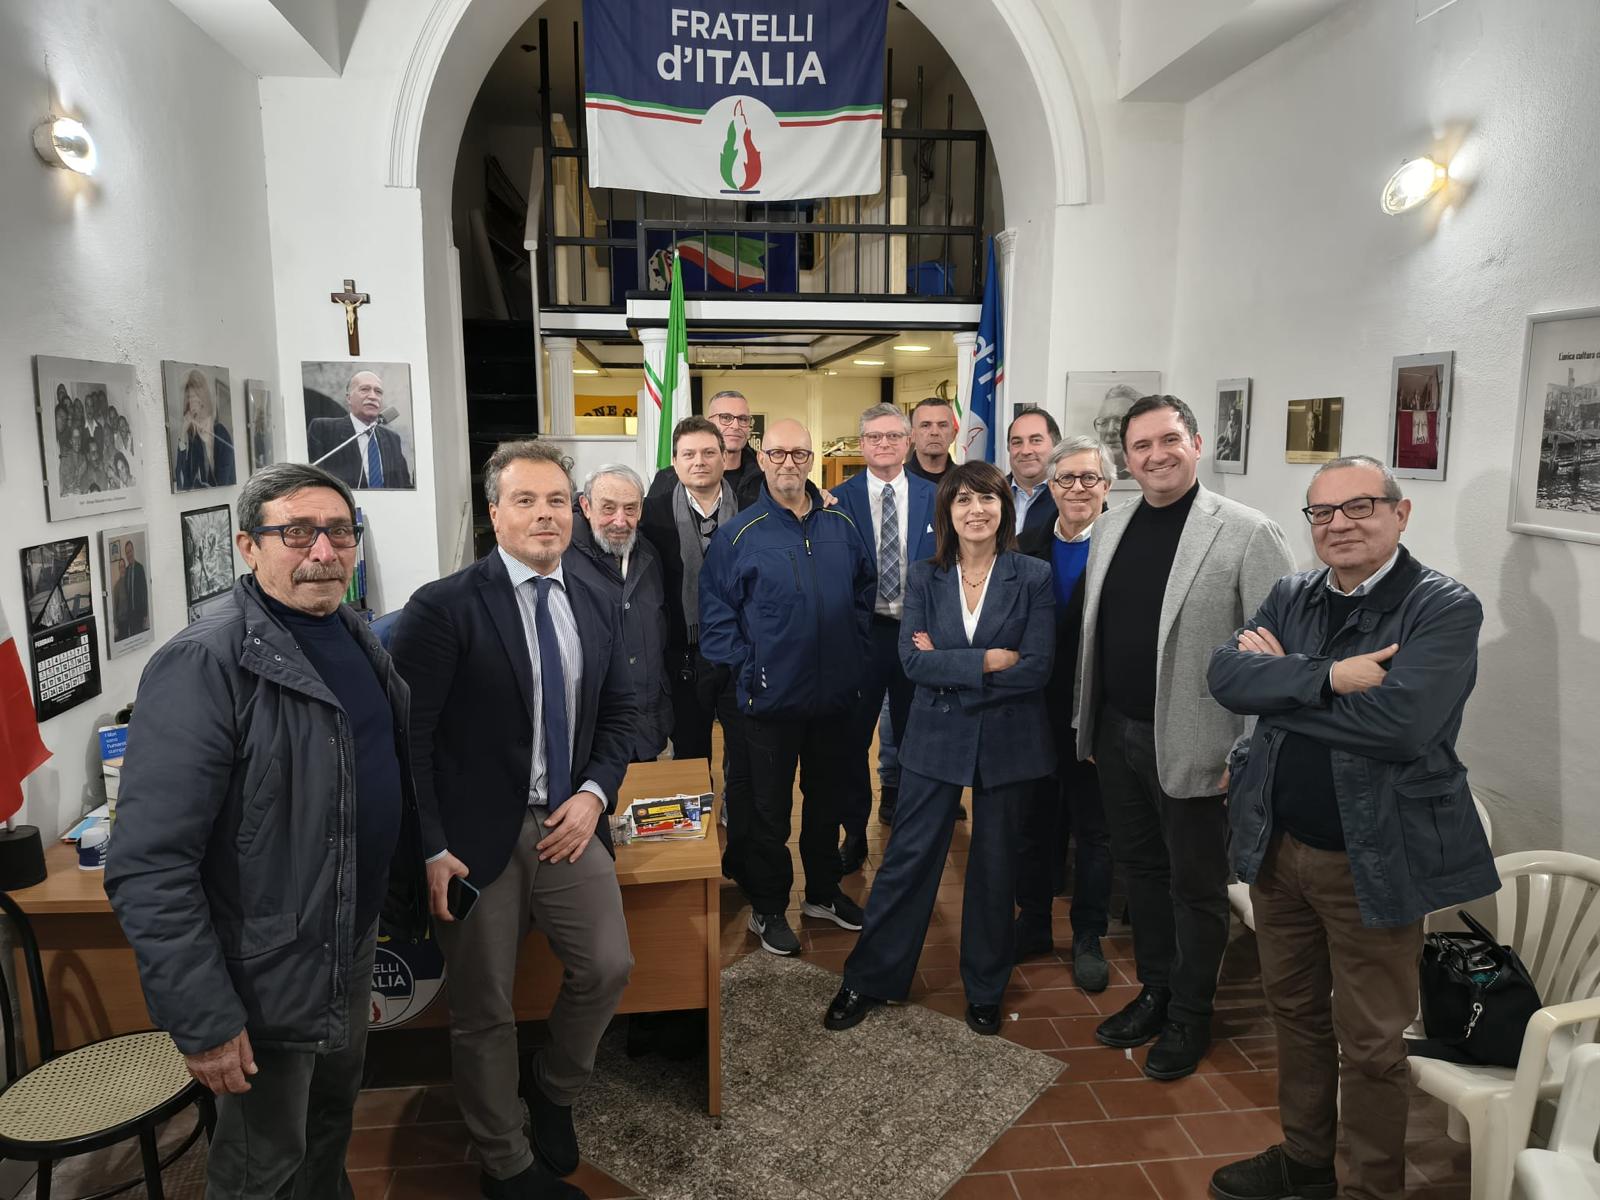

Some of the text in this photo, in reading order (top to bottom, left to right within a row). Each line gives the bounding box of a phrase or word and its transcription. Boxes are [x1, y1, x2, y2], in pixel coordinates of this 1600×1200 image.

[671, 8, 813, 42] FRATELLI
[656, 44, 827, 86] d'ITALIA
[373, 963, 399, 973] ELLI
